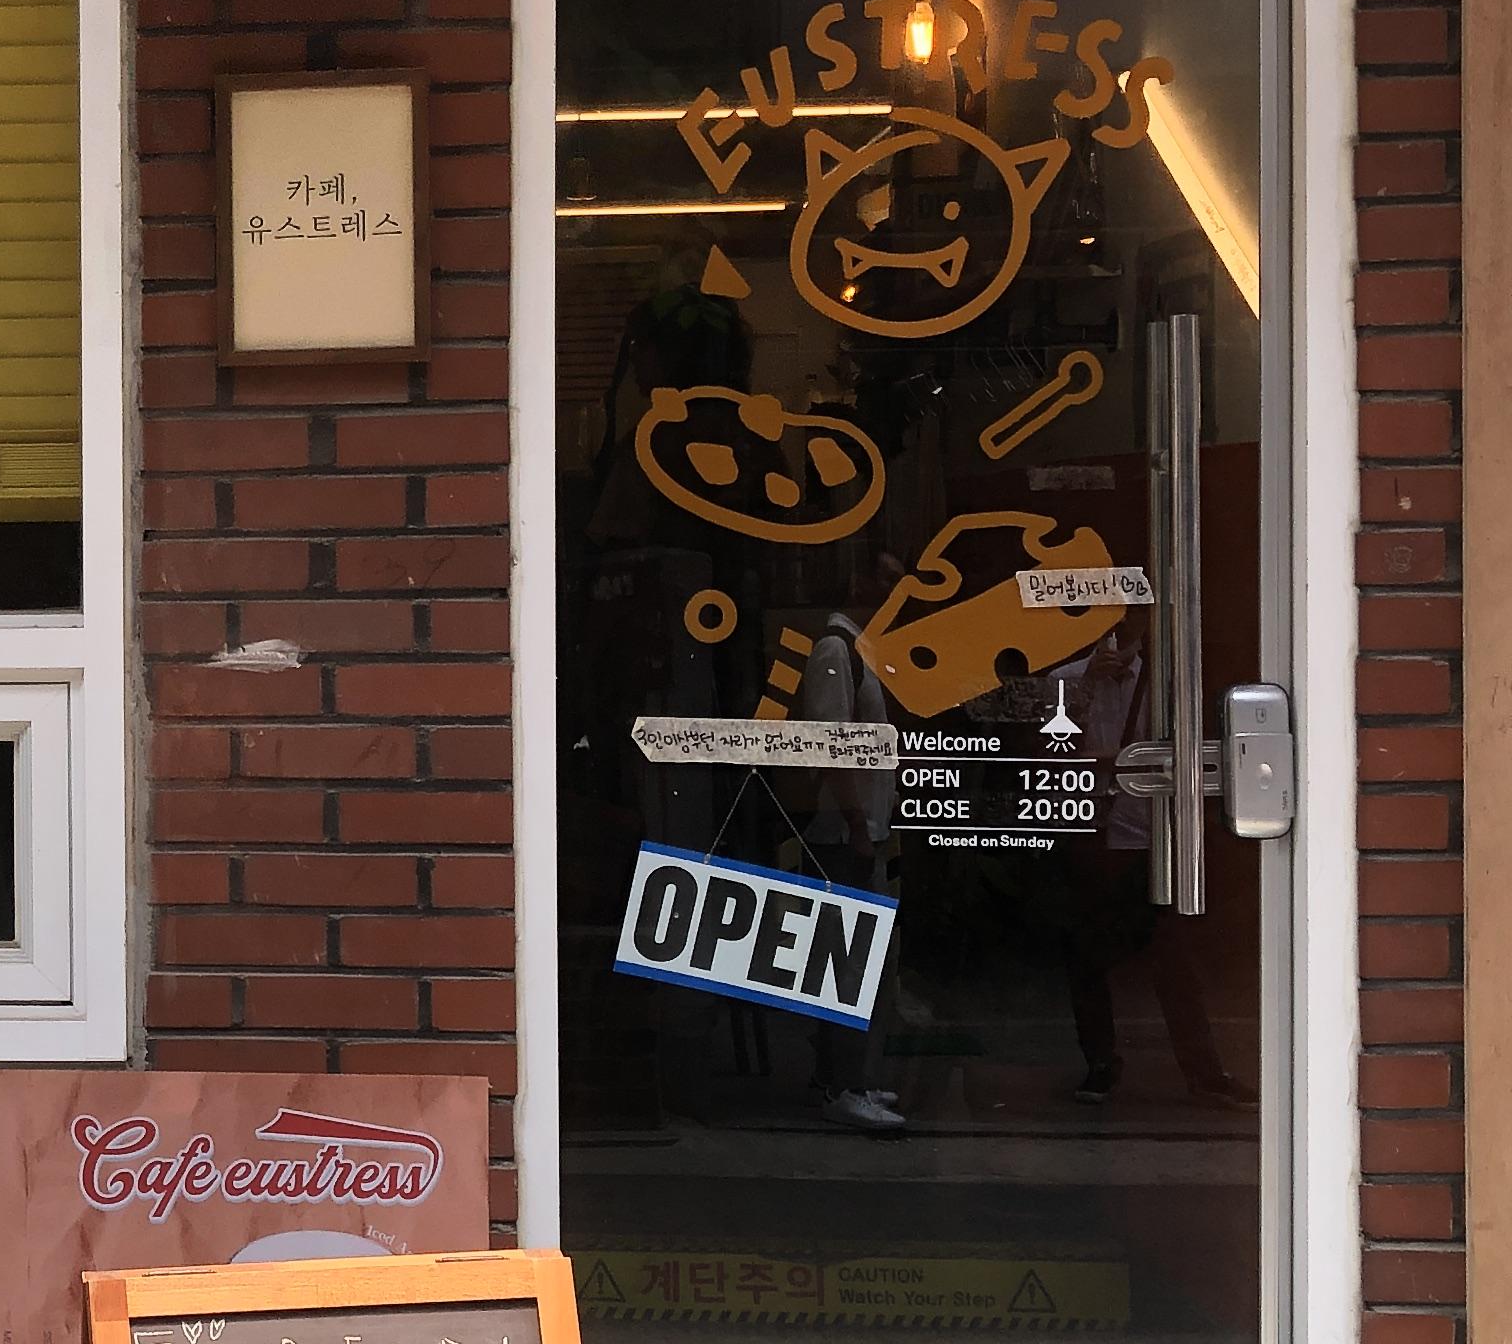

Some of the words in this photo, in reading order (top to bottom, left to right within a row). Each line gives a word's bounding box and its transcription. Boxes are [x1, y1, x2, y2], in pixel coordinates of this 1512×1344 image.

[287, 173, 357, 206] 카페,
[242, 209, 403, 245] 유스트레스
[902, 731, 1001, 752] Welcome
[901, 769, 960, 788] OPEN
[1018, 769, 1095, 792] 12:00
[900, 799, 970, 819] CLOSE
[1018, 799, 1095, 821] 20:00
[928, 834, 978, 847] Closed
[981, 838, 999, 847] on
[1000, 834, 1055, 851] Sunday
[632, 864, 879, 1008] OPEN
[71, 1114, 220, 1224] Cafe
[222, 1108, 444, 1206] eustress
[641, 1259, 826, 1307] 계단주의
[838, 1267, 924, 1285] CAUTION
[838, 1288, 896, 1308] Watch
[904, 1289, 944, 1307] Your
[953, 1290, 996, 1310] Step
